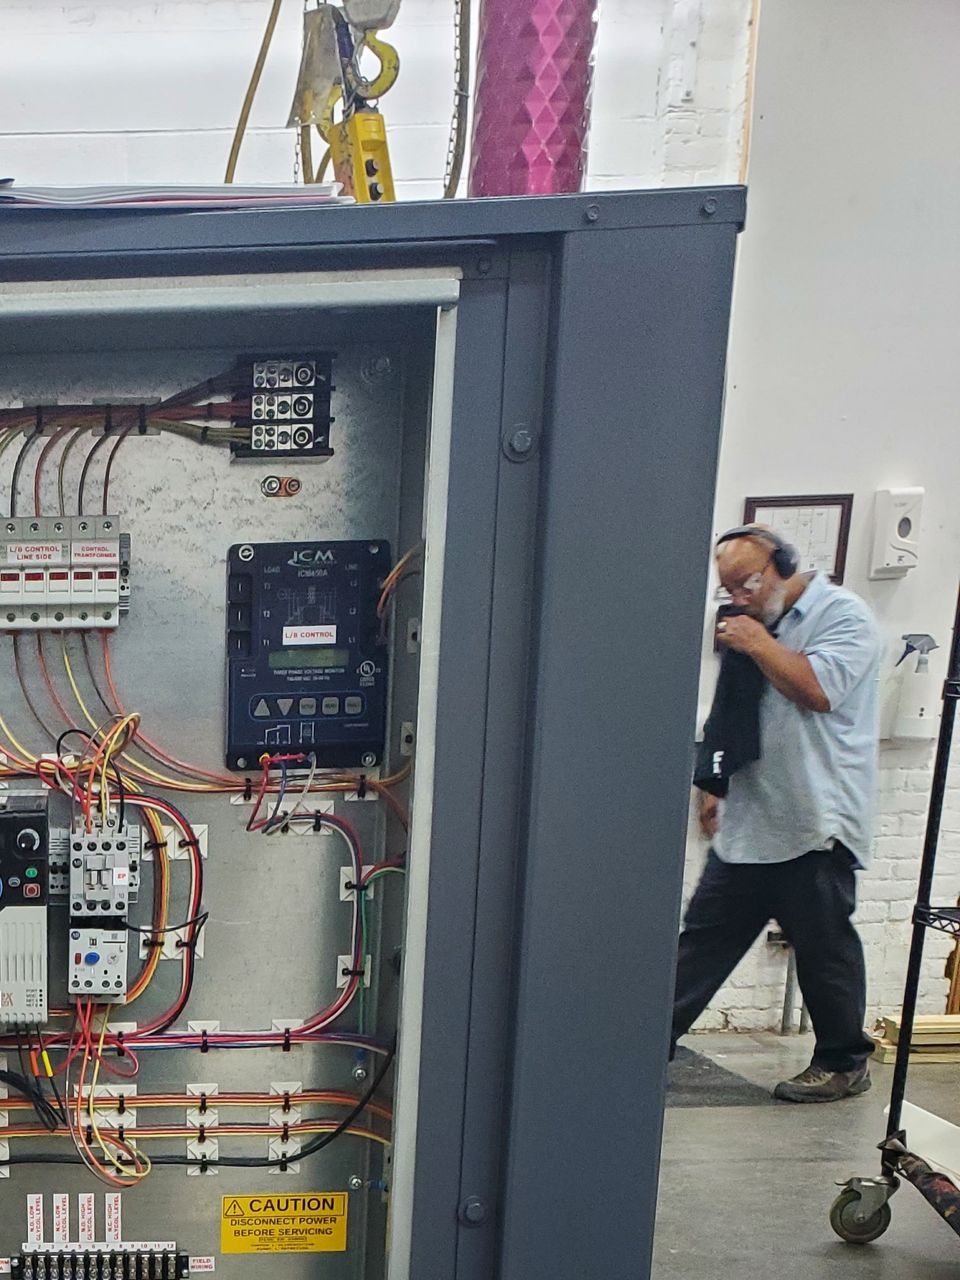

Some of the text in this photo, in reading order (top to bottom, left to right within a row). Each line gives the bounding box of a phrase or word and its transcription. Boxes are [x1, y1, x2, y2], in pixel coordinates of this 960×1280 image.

[289, 550, 334, 564] ICM
[249, 1198, 334, 1212] CAUTION
[230, 1218, 296, 1226] DISCONNECT
